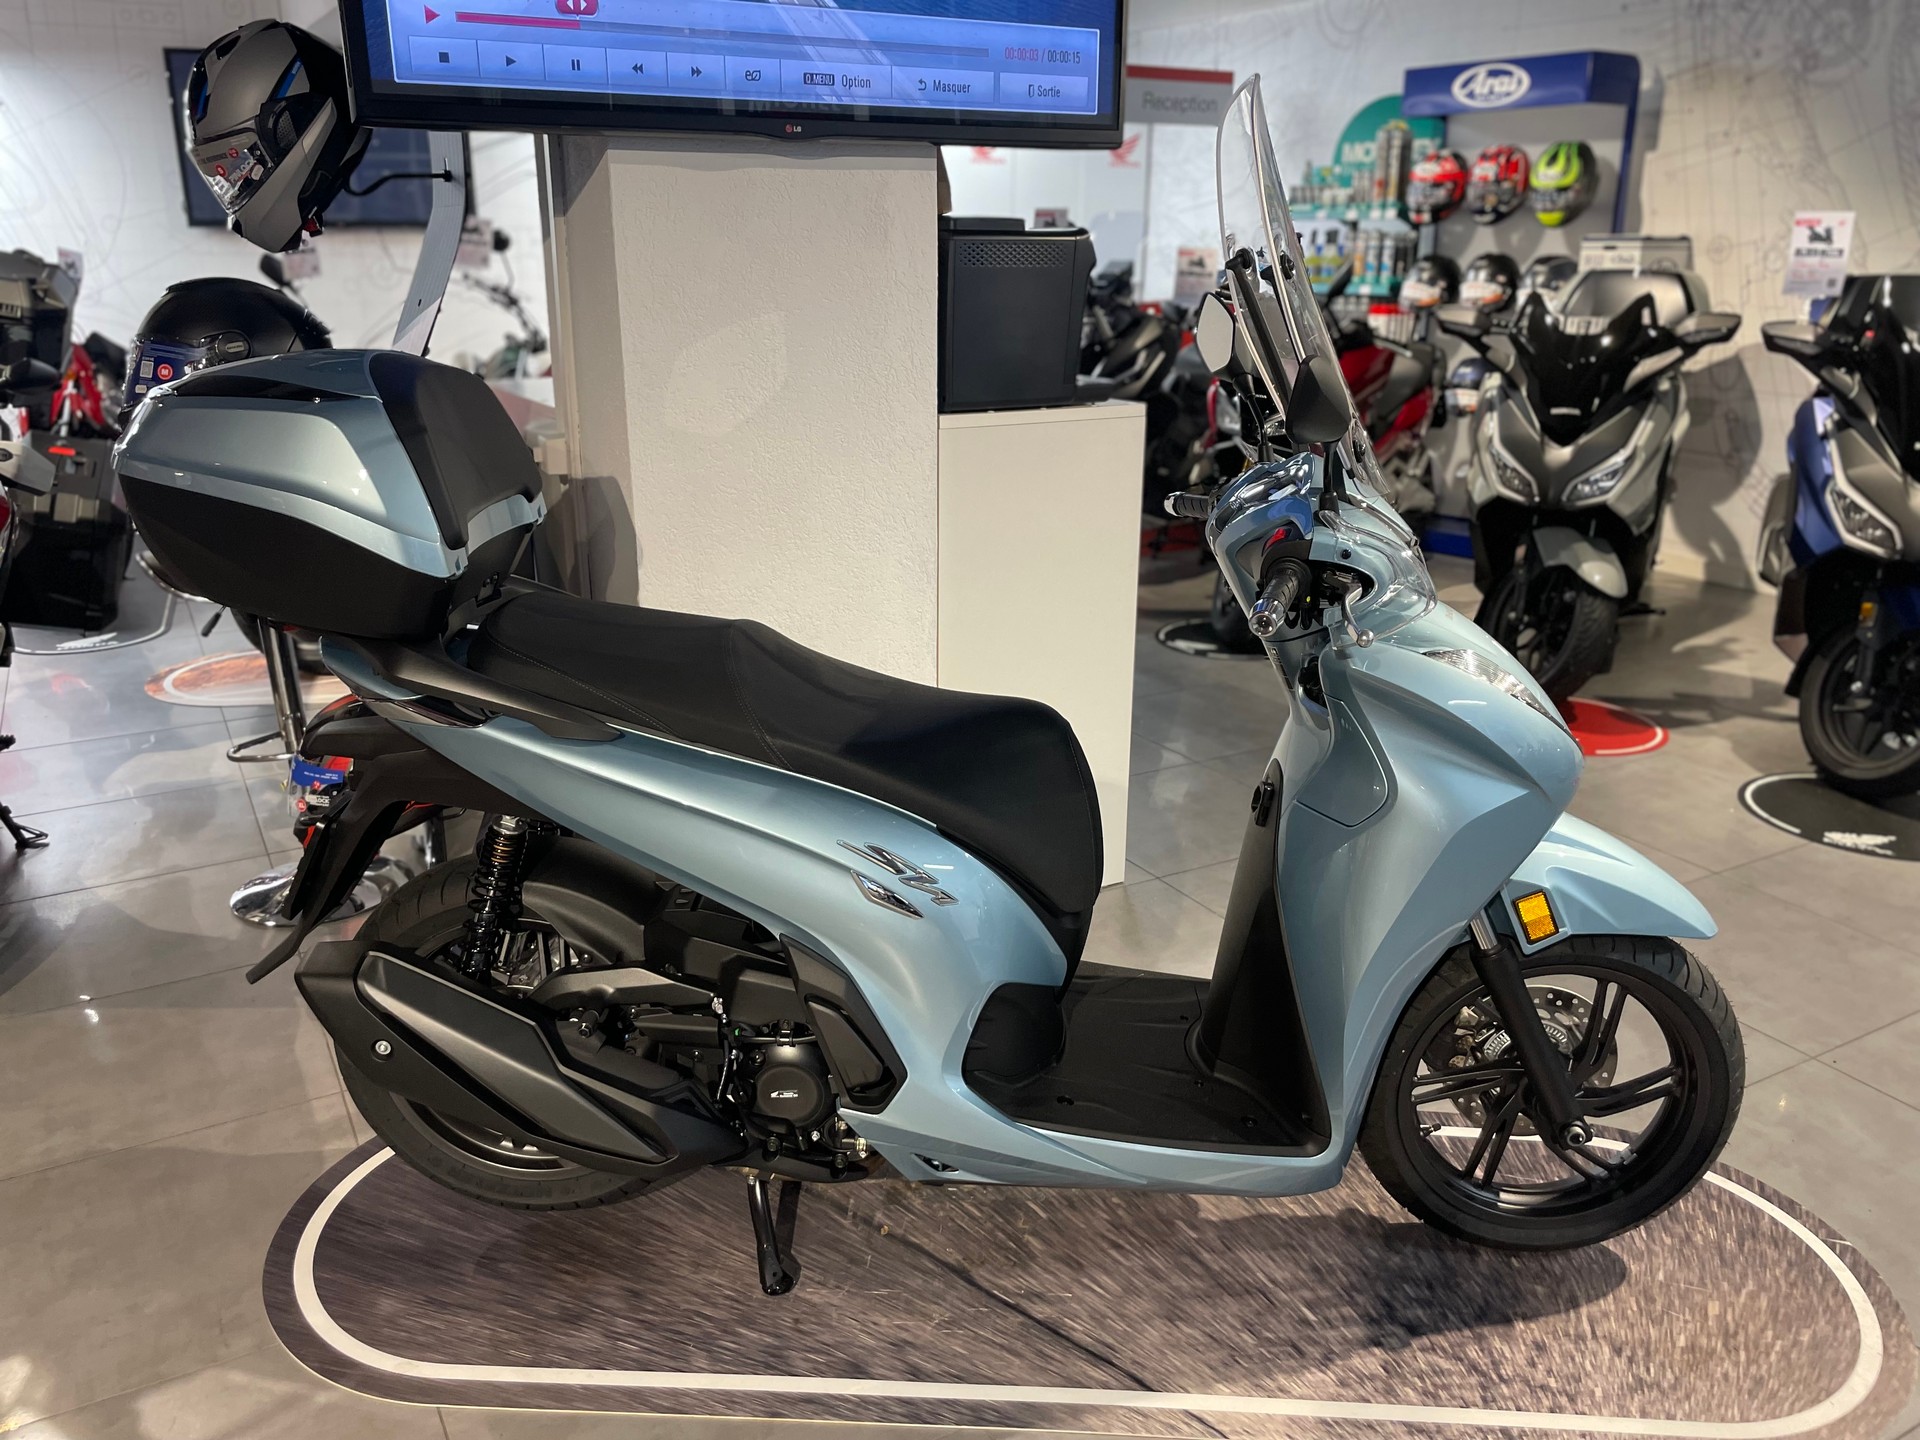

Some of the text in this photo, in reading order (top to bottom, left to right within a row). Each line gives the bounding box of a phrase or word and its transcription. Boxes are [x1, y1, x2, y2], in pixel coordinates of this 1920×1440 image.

[1004, 47, 1039, 61] 00:00:03
[1047, 49, 1081, 64] 00:00:15
[841, 74, 871, 89] Option
[932, 79, 971, 95] Masquer
[1461, 68, 1519, 97] Arai
[1037, 84, 1061, 98] Sortie
